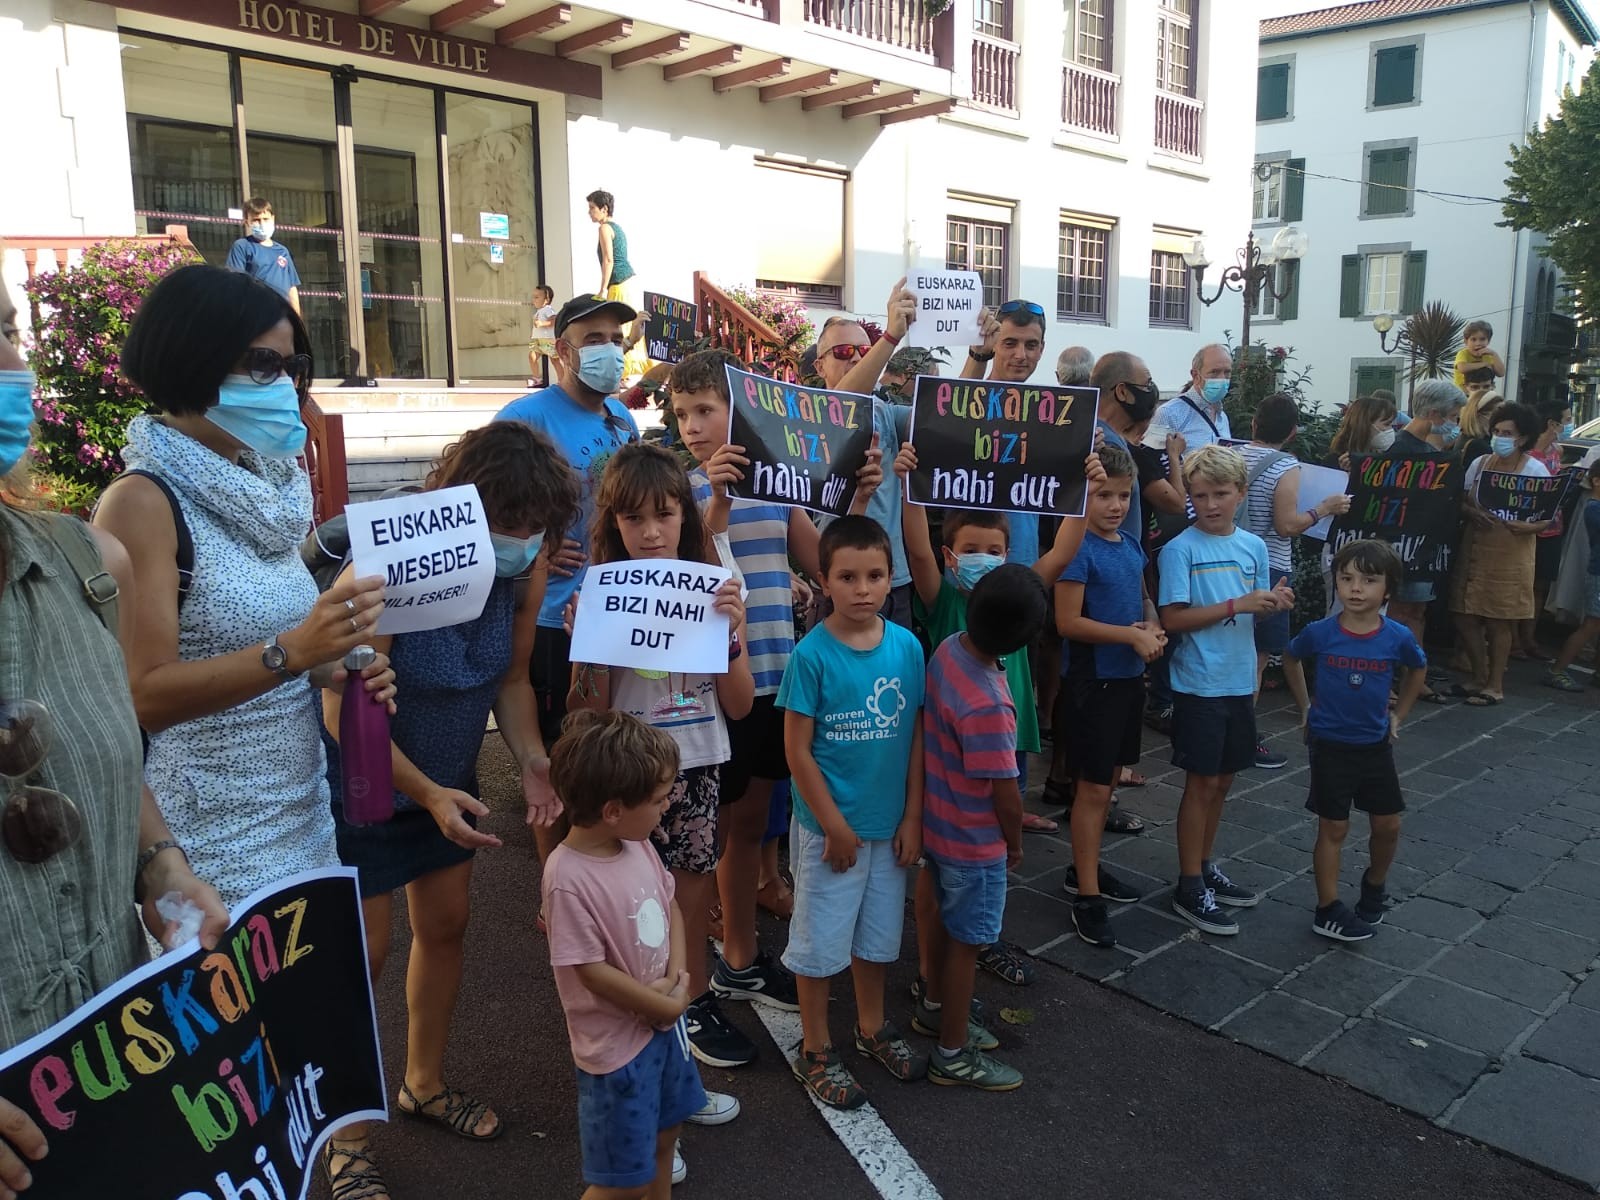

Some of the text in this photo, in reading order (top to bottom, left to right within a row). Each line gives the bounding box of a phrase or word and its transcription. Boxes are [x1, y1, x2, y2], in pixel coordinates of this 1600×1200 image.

[238, 0, 490, 73] HOTEL DE VILLE
[917, 276, 975, 291] EUSKARAZ
[652, 294, 692, 323] euskaraz
[922, 297, 972, 311] BIZI NAHI
[662, 319, 680, 341] bizi
[936, 319, 960, 332] DUT
[649, 338, 669, 360] nahi
[743, 376, 859, 430] euskaraz
[936, 382, 1074, 427] euskaraz
[783, 424, 831, 465] bizi
[974, 427, 1028, 465] bizi
[753, 460, 812, 503] nahi
[1360, 456, 1450, 490] euskaraz
[1490, 473, 1561, 492] euskaraz
[931, 467, 1061, 509] nahi dut
[1508, 492, 1537, 510] bizi
[371, 501, 477, 546] EUSKARAZ
[1363, 493, 1409, 528] bizi
[386, 541, 479, 587] MESEDEZ
[417, 583, 470, 606] ESKER!!
[599, 569, 721, 595] EUSKARAZ
[605, 595, 705, 622] BIZI NAHI
[630, 628, 675, 650] DUT
[825, 709, 865, 722] ororen
[834, 718, 872, 731] gaindi
[29, 897, 315, 1131] euskaraz
[171, 1021, 282, 1153] bizi
